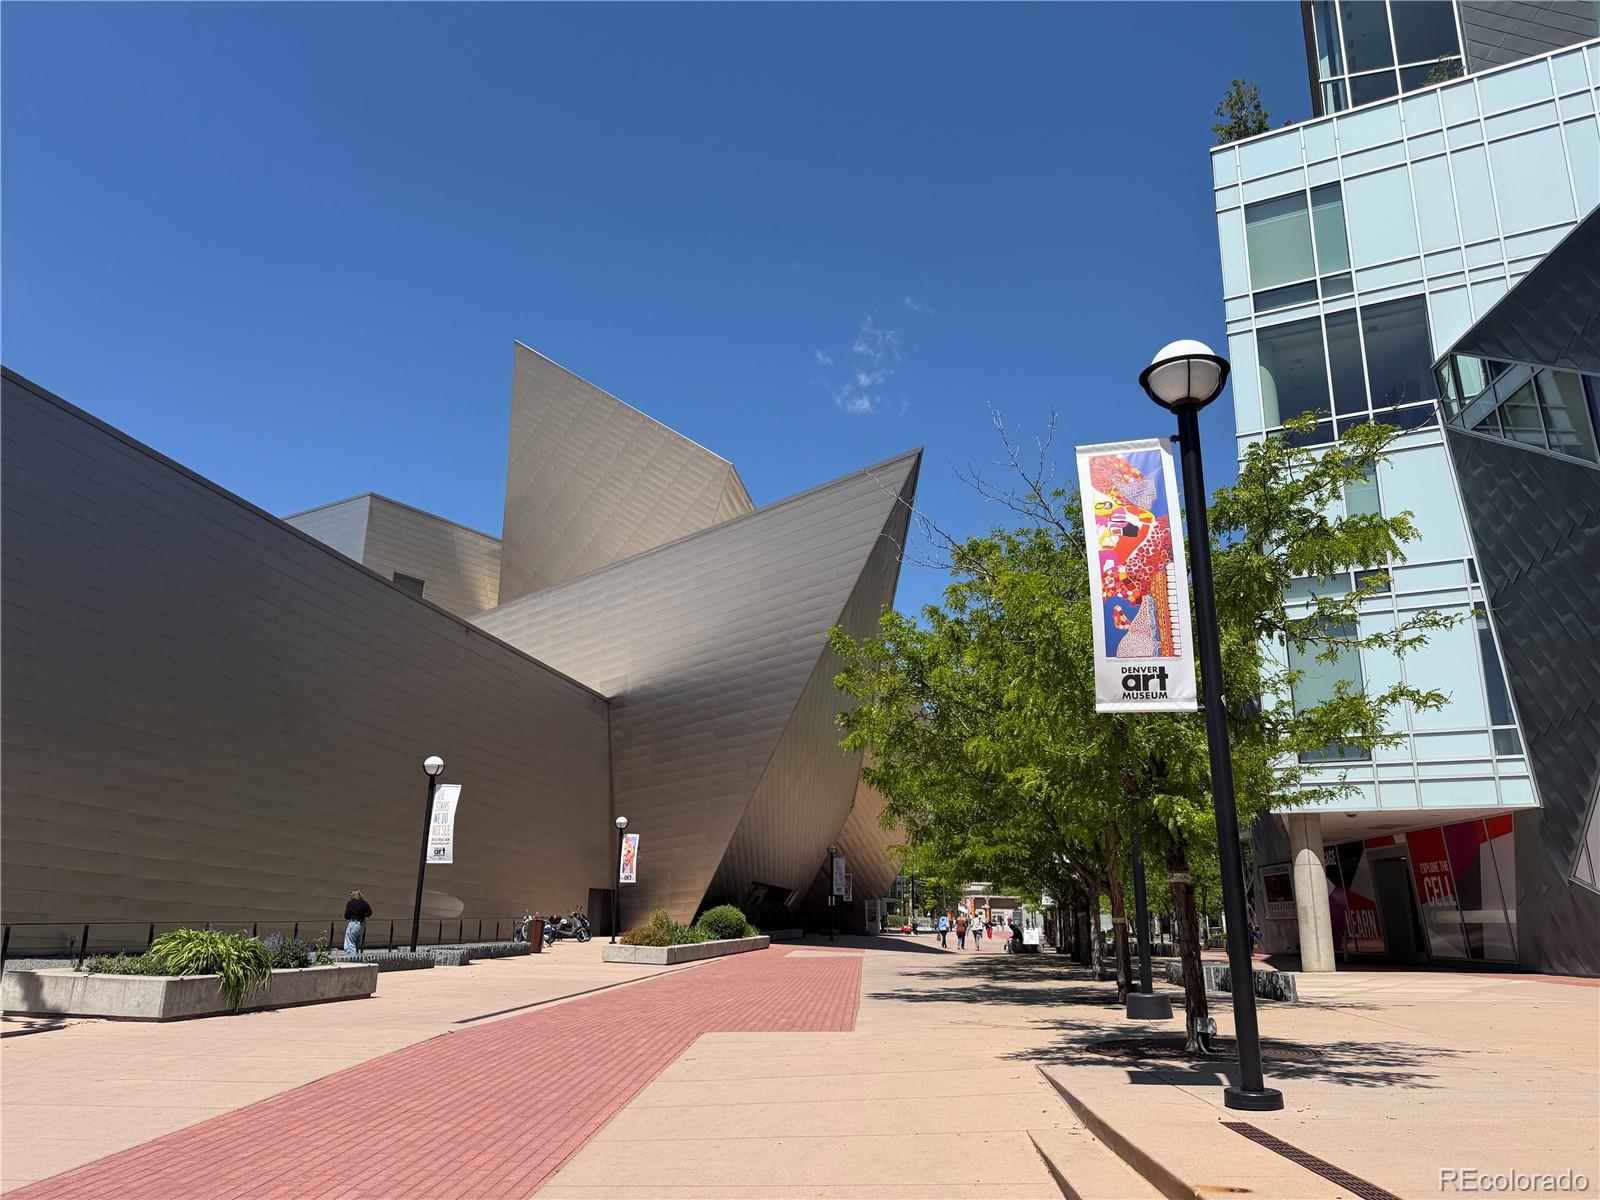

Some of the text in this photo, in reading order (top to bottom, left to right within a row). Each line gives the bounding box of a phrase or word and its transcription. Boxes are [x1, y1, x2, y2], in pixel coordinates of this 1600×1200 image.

[1121, 666, 1158, 674] DENVER
[1121, 666, 1169, 692] art
[1122, 691, 1168, 700] MUSEUM
[1420, 860, 1450, 874] EXPLORE THE
[1423, 875, 1457, 907] CELL
[1344, 908, 1379, 938] LEARN
